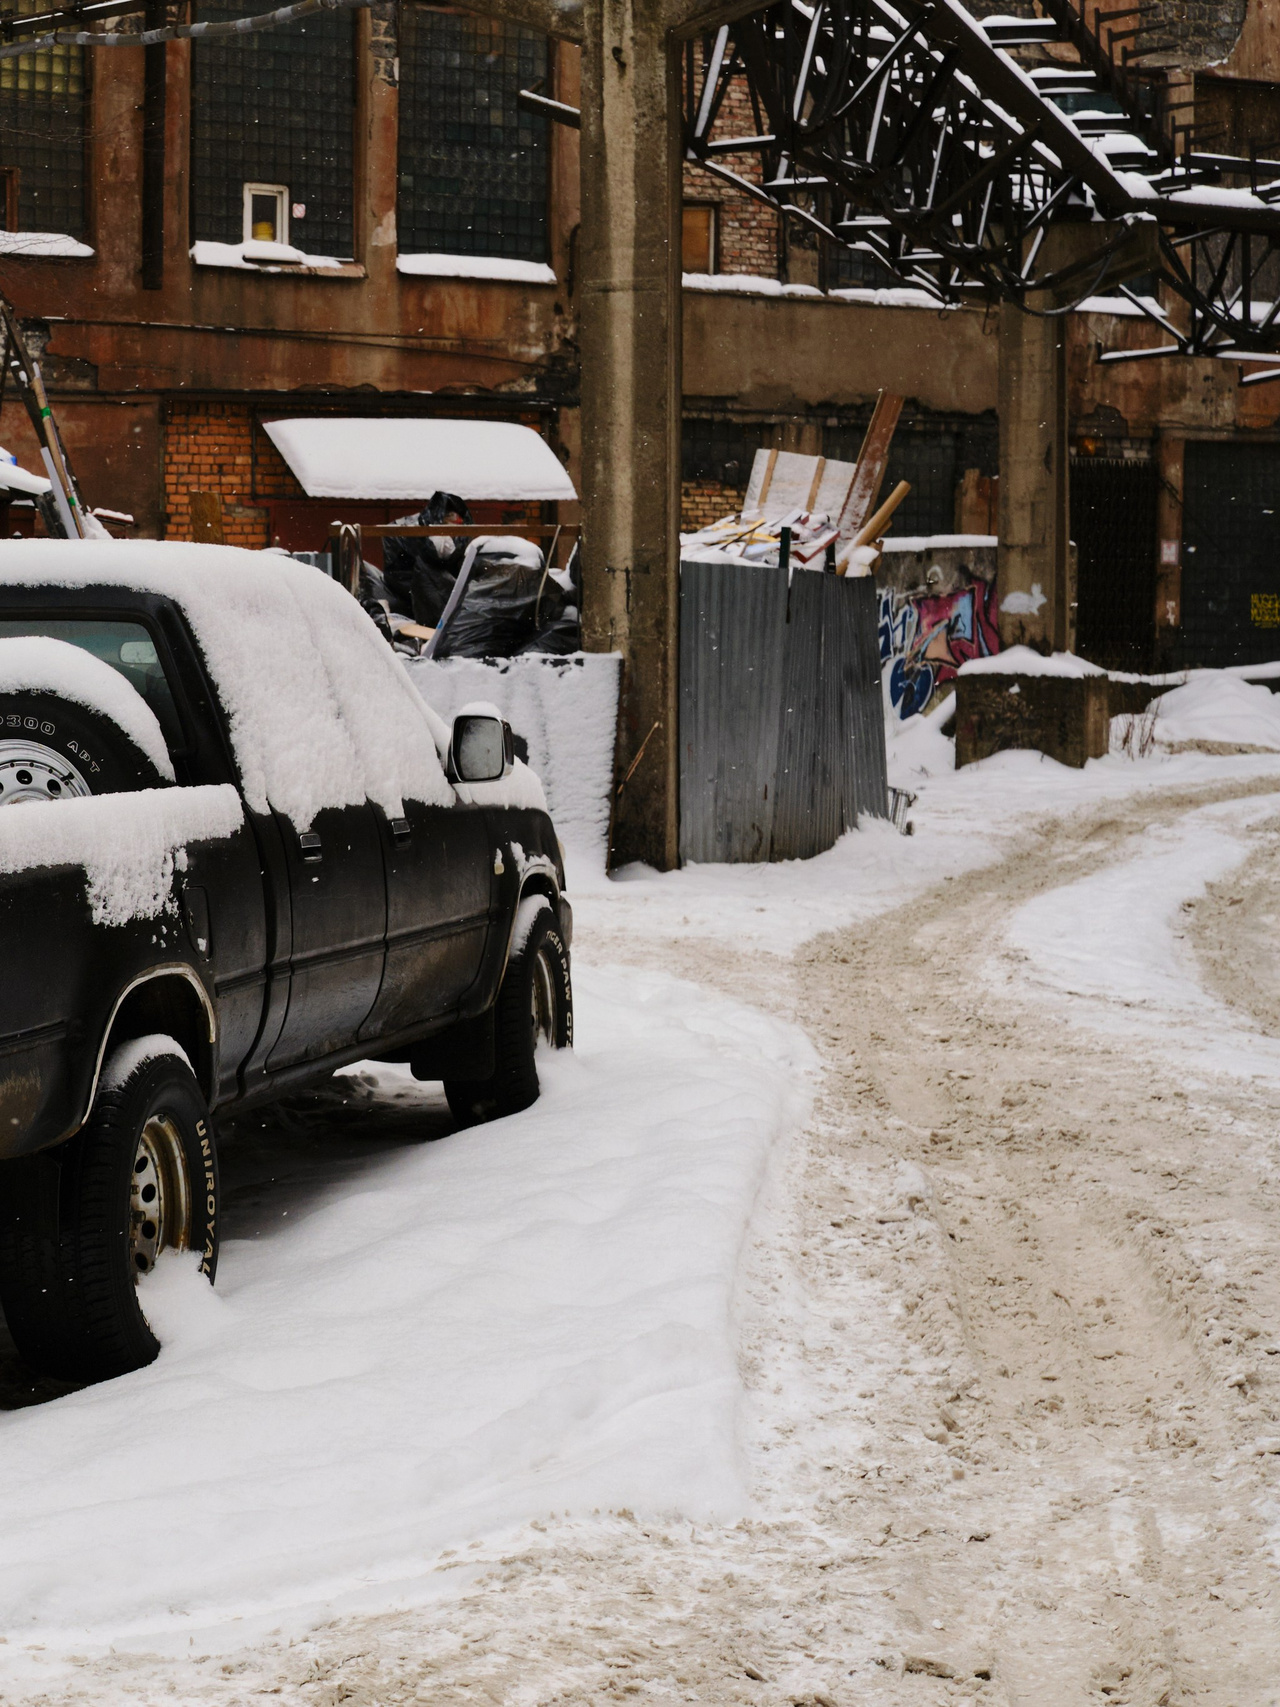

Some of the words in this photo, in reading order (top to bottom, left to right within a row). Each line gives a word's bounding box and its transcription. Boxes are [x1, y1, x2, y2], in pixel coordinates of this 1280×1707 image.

[67, 740, 100, 773] APT
[546, 930, 563, 954] TIGER
[561, 957, 571, 1001] PAW
[196, 1120, 216, 1274] UNIROYAL
